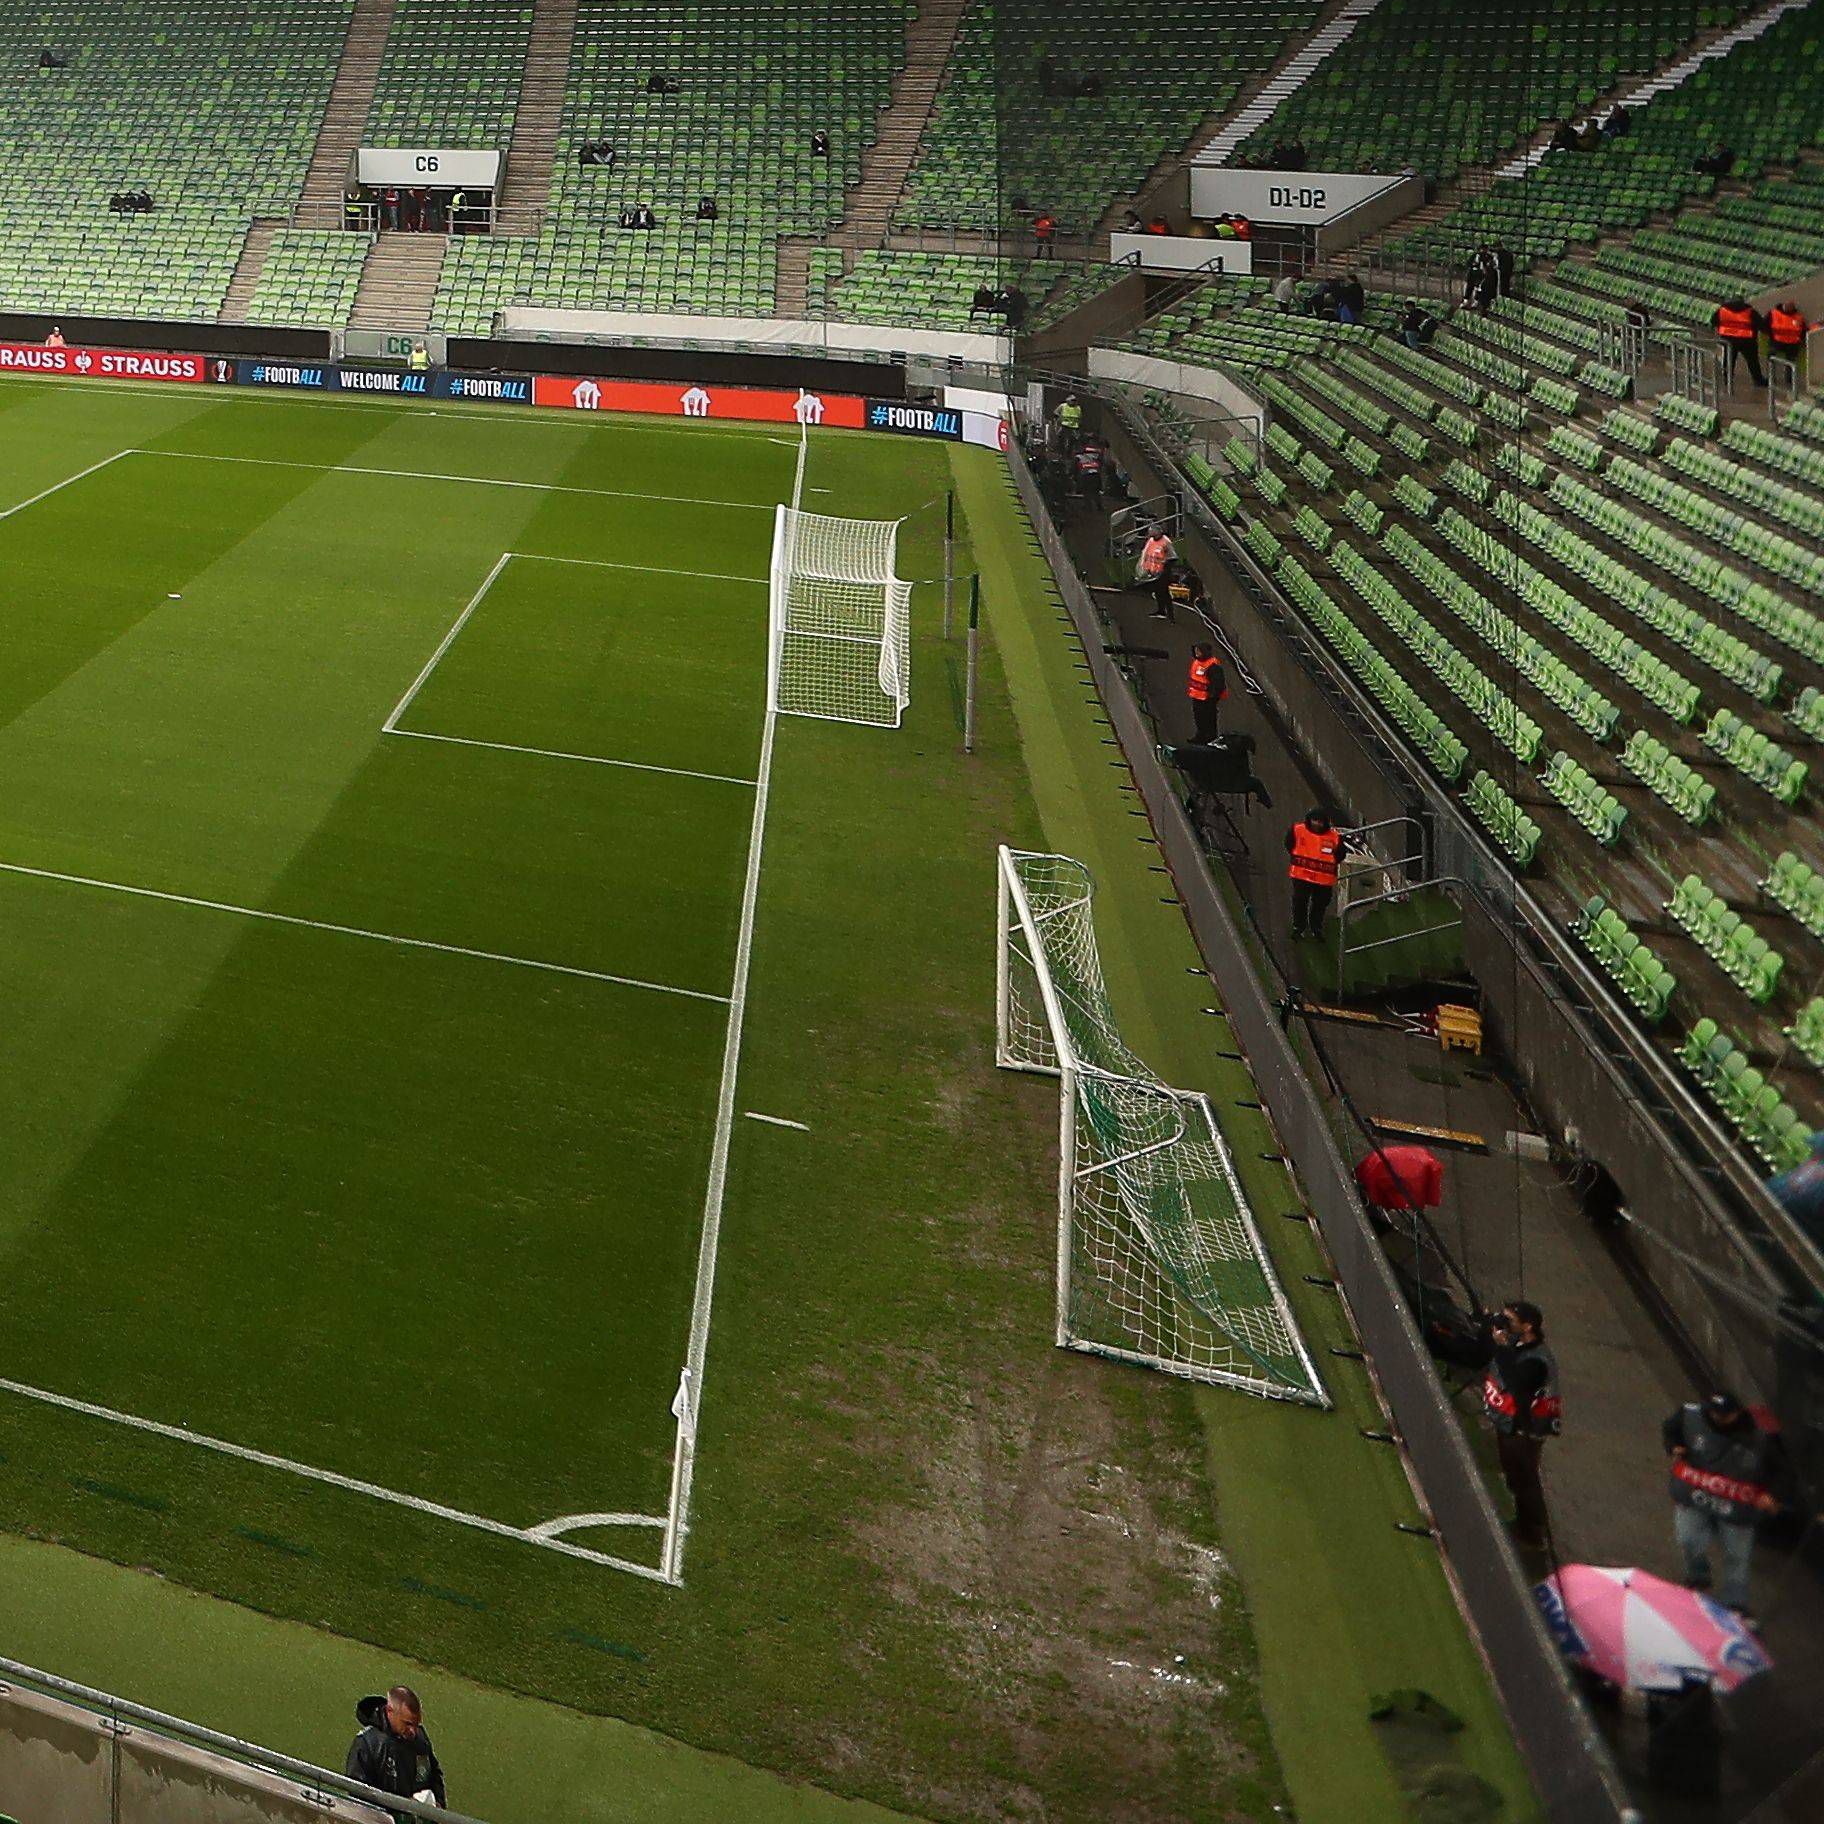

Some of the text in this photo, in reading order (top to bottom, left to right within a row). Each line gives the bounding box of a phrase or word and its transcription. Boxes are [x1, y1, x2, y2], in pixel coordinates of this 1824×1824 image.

[415, 156, 439, 172] C6
[1269, 187, 1326, 210] D1-D2
[387, 337, 412, 356] C6
[101, 356, 196, 377] STRAUSS
[252, 366, 322, 386] #FOOTBALL
[340, 371, 426, 392] WELCOME ALL
[449, 378, 526, 399] #FOOTBALL
[871, 405, 959, 435] #FOOTBALL
